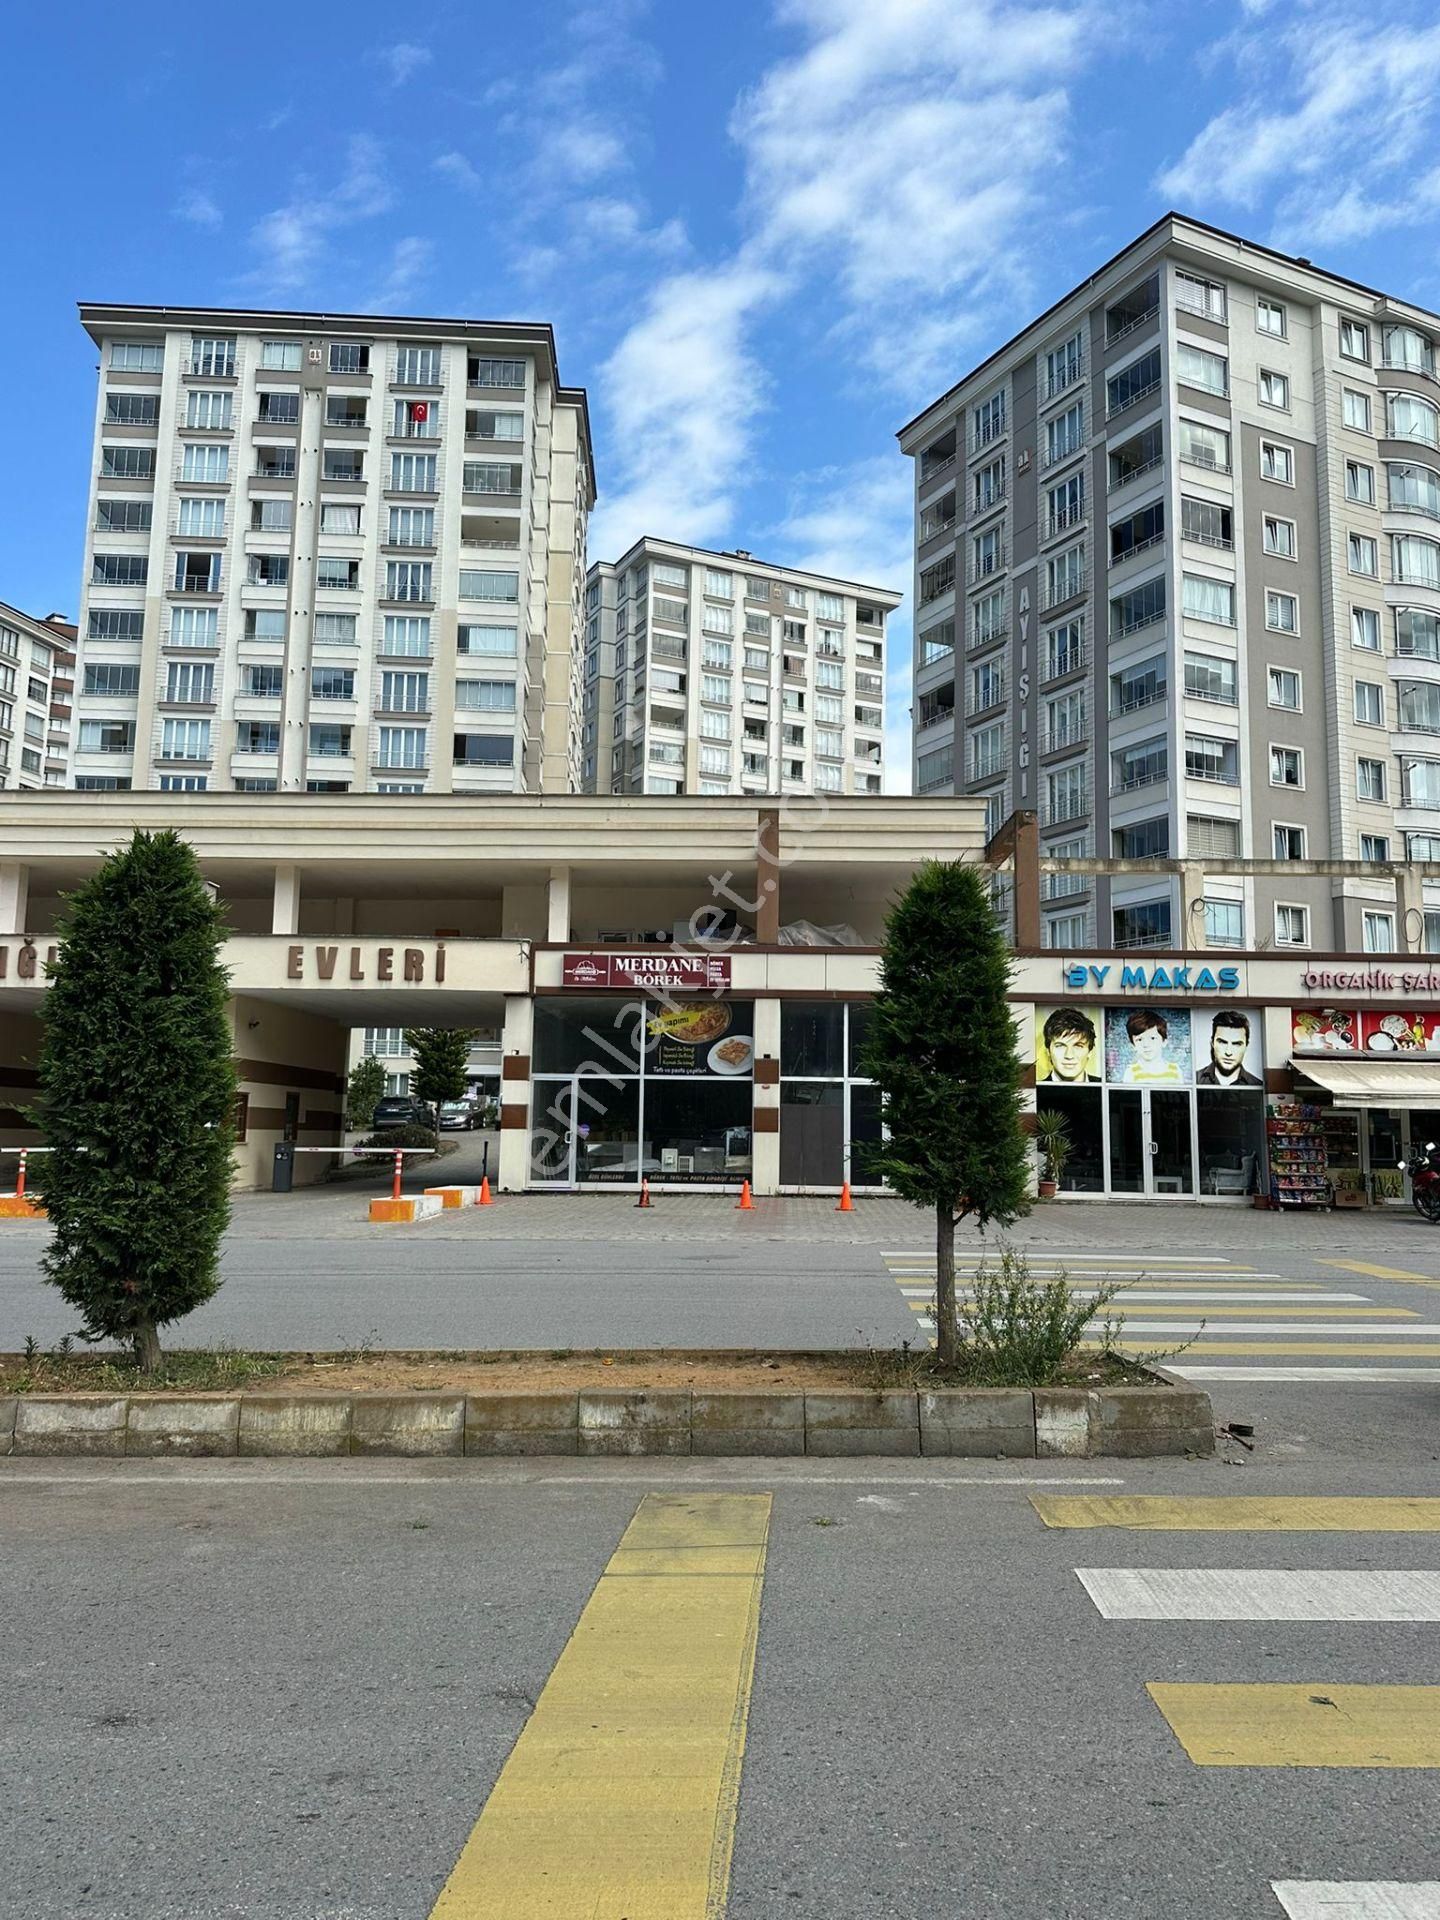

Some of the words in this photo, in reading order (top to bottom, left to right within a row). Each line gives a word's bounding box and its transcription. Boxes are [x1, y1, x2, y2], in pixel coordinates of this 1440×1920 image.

[1019, 586, 1031, 799] AYIŞIĞI
[287, 942, 446, 982] EVLERİ
[615, 958, 704, 973] MERDANE
[633, 972, 684, 986] BÖREK
[1067, 965, 1111, 988] BY
[1120, 966, 1241, 990] MAKAS
[1304, 969, 1395, 991] ORGANİK
